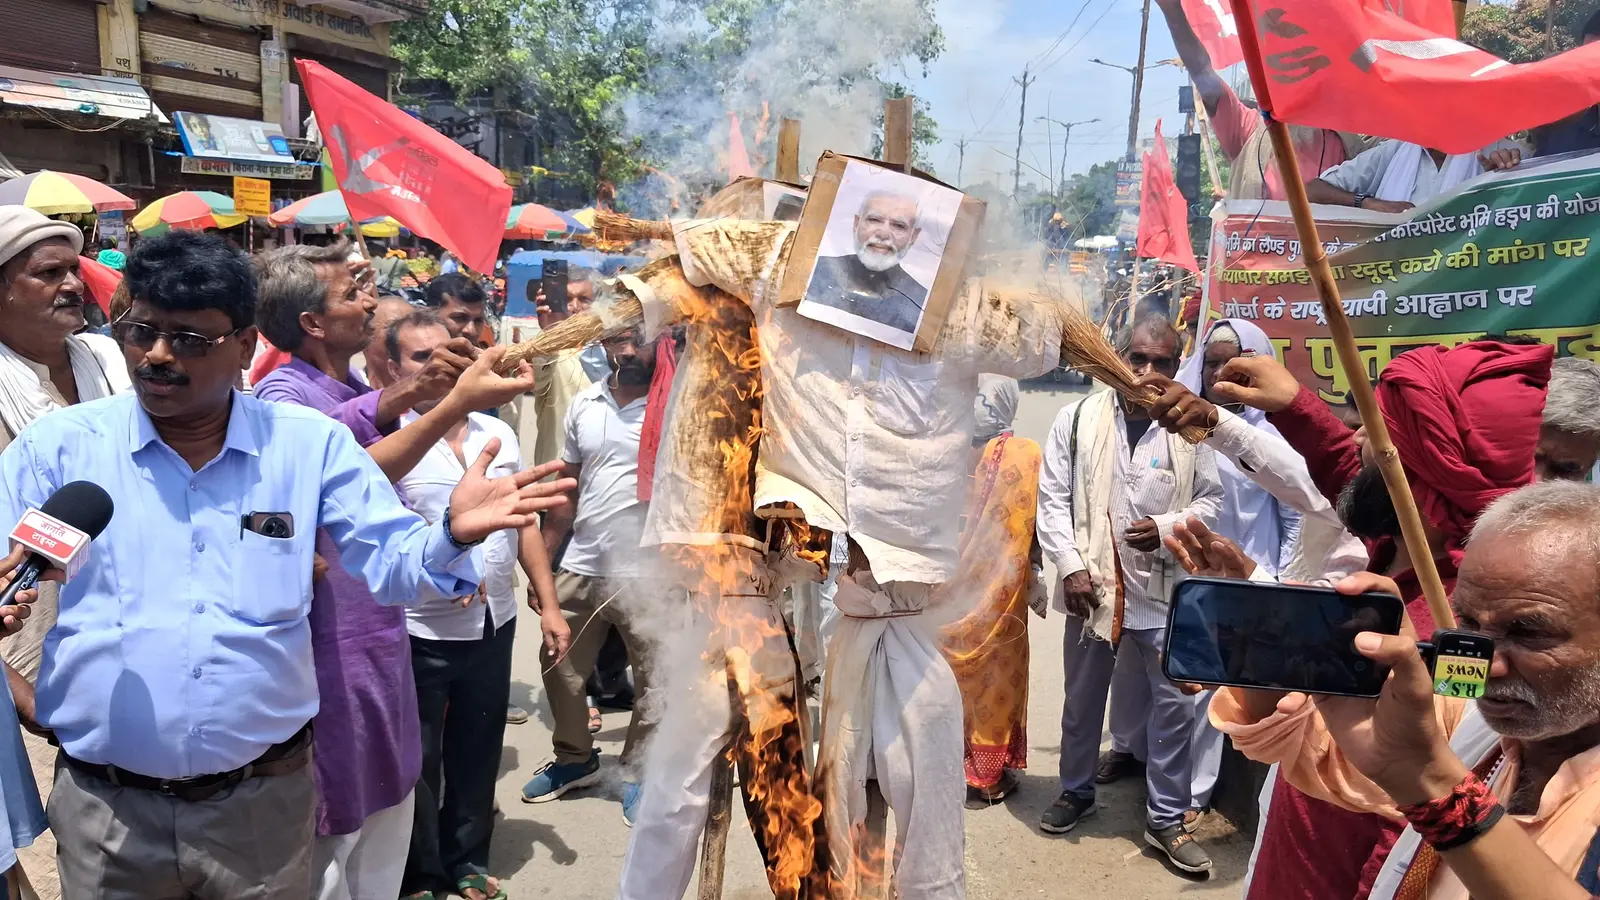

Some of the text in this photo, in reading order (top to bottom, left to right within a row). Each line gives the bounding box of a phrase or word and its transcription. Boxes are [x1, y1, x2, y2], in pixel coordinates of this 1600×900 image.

[1459, 204, 1492, 237] भूमि
[1536, 194, 1560, 220] की
[1398, 248, 1443, 275] करो
[1445, 242, 1480, 270] की
[1487, 238, 1546, 265] मांग
[1552, 237, 1591, 258] पर
[1263, 295, 1286, 319] के
[1496, 284, 1537, 306] पर
[1446, 663, 1486, 680] News
[1451, 681, 1479, 698] R.S
